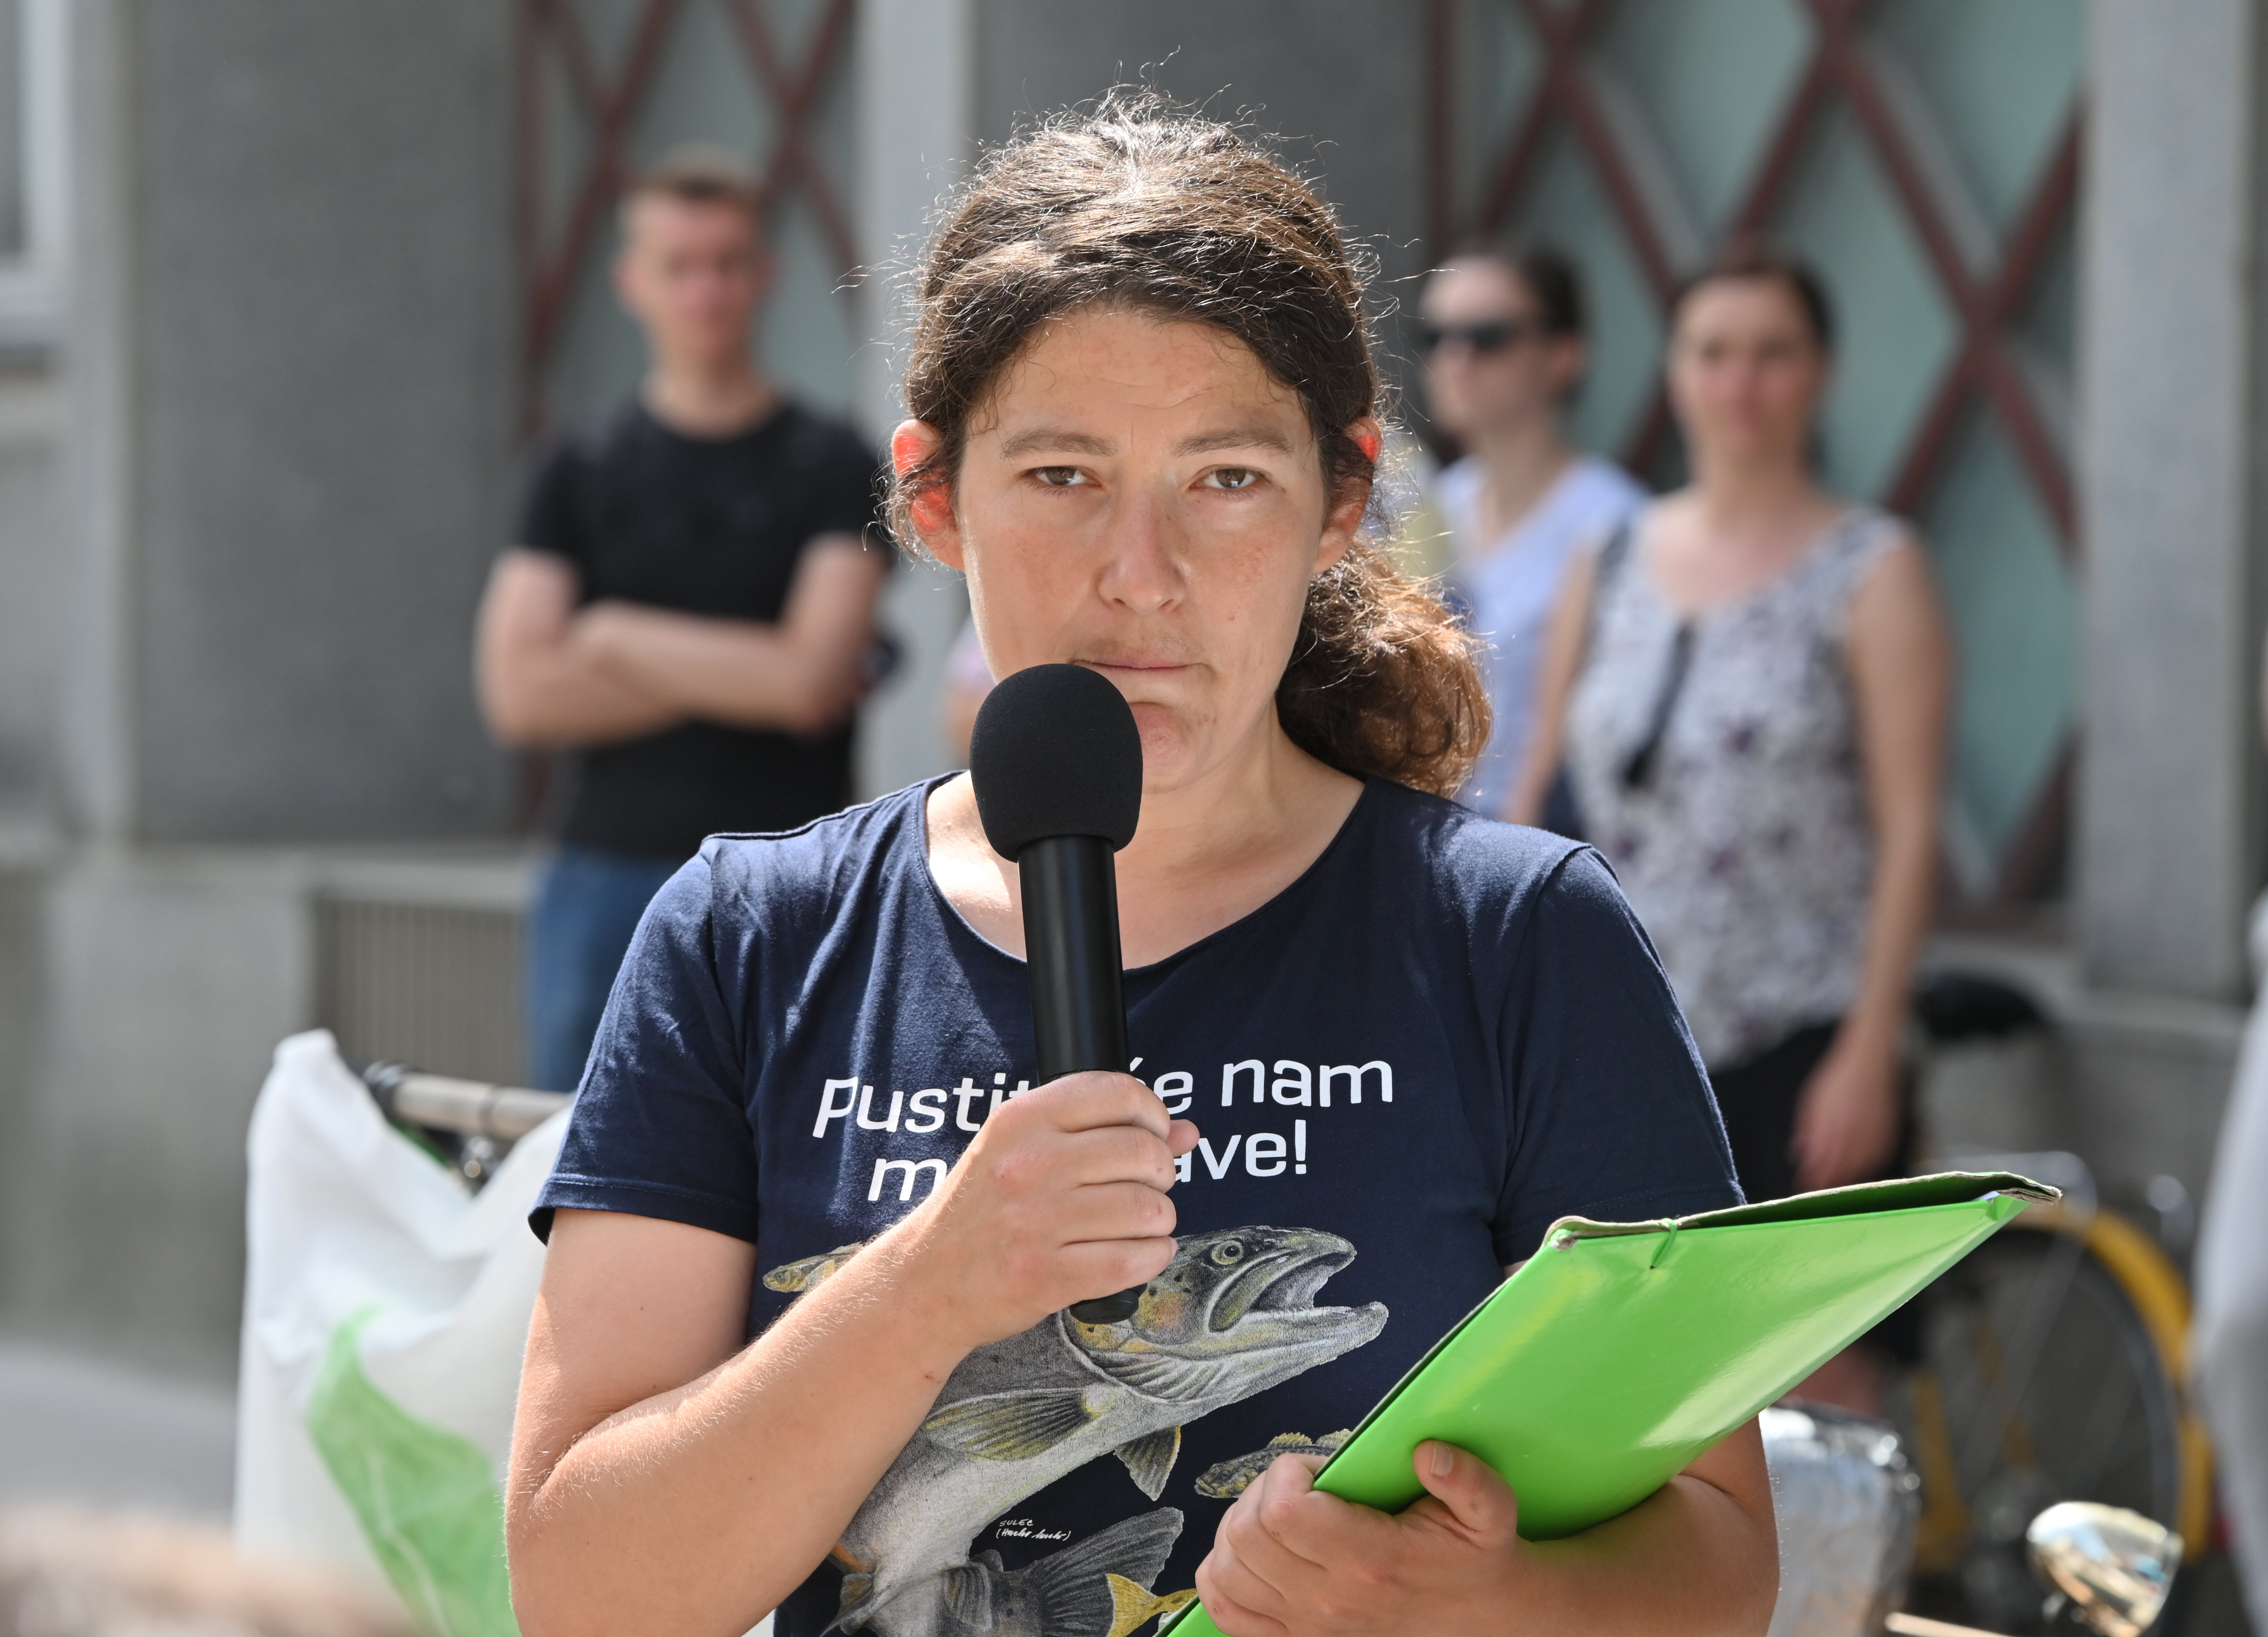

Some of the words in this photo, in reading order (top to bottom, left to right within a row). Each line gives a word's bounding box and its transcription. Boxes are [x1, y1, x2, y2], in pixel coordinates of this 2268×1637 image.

[812, 1072, 1029, 1138] Pusti
[1130, 1057, 1193, 1115] e
[1221, 1059, 1393, 1107] nam
[999, 1519, 1033, 1527] SULEC
